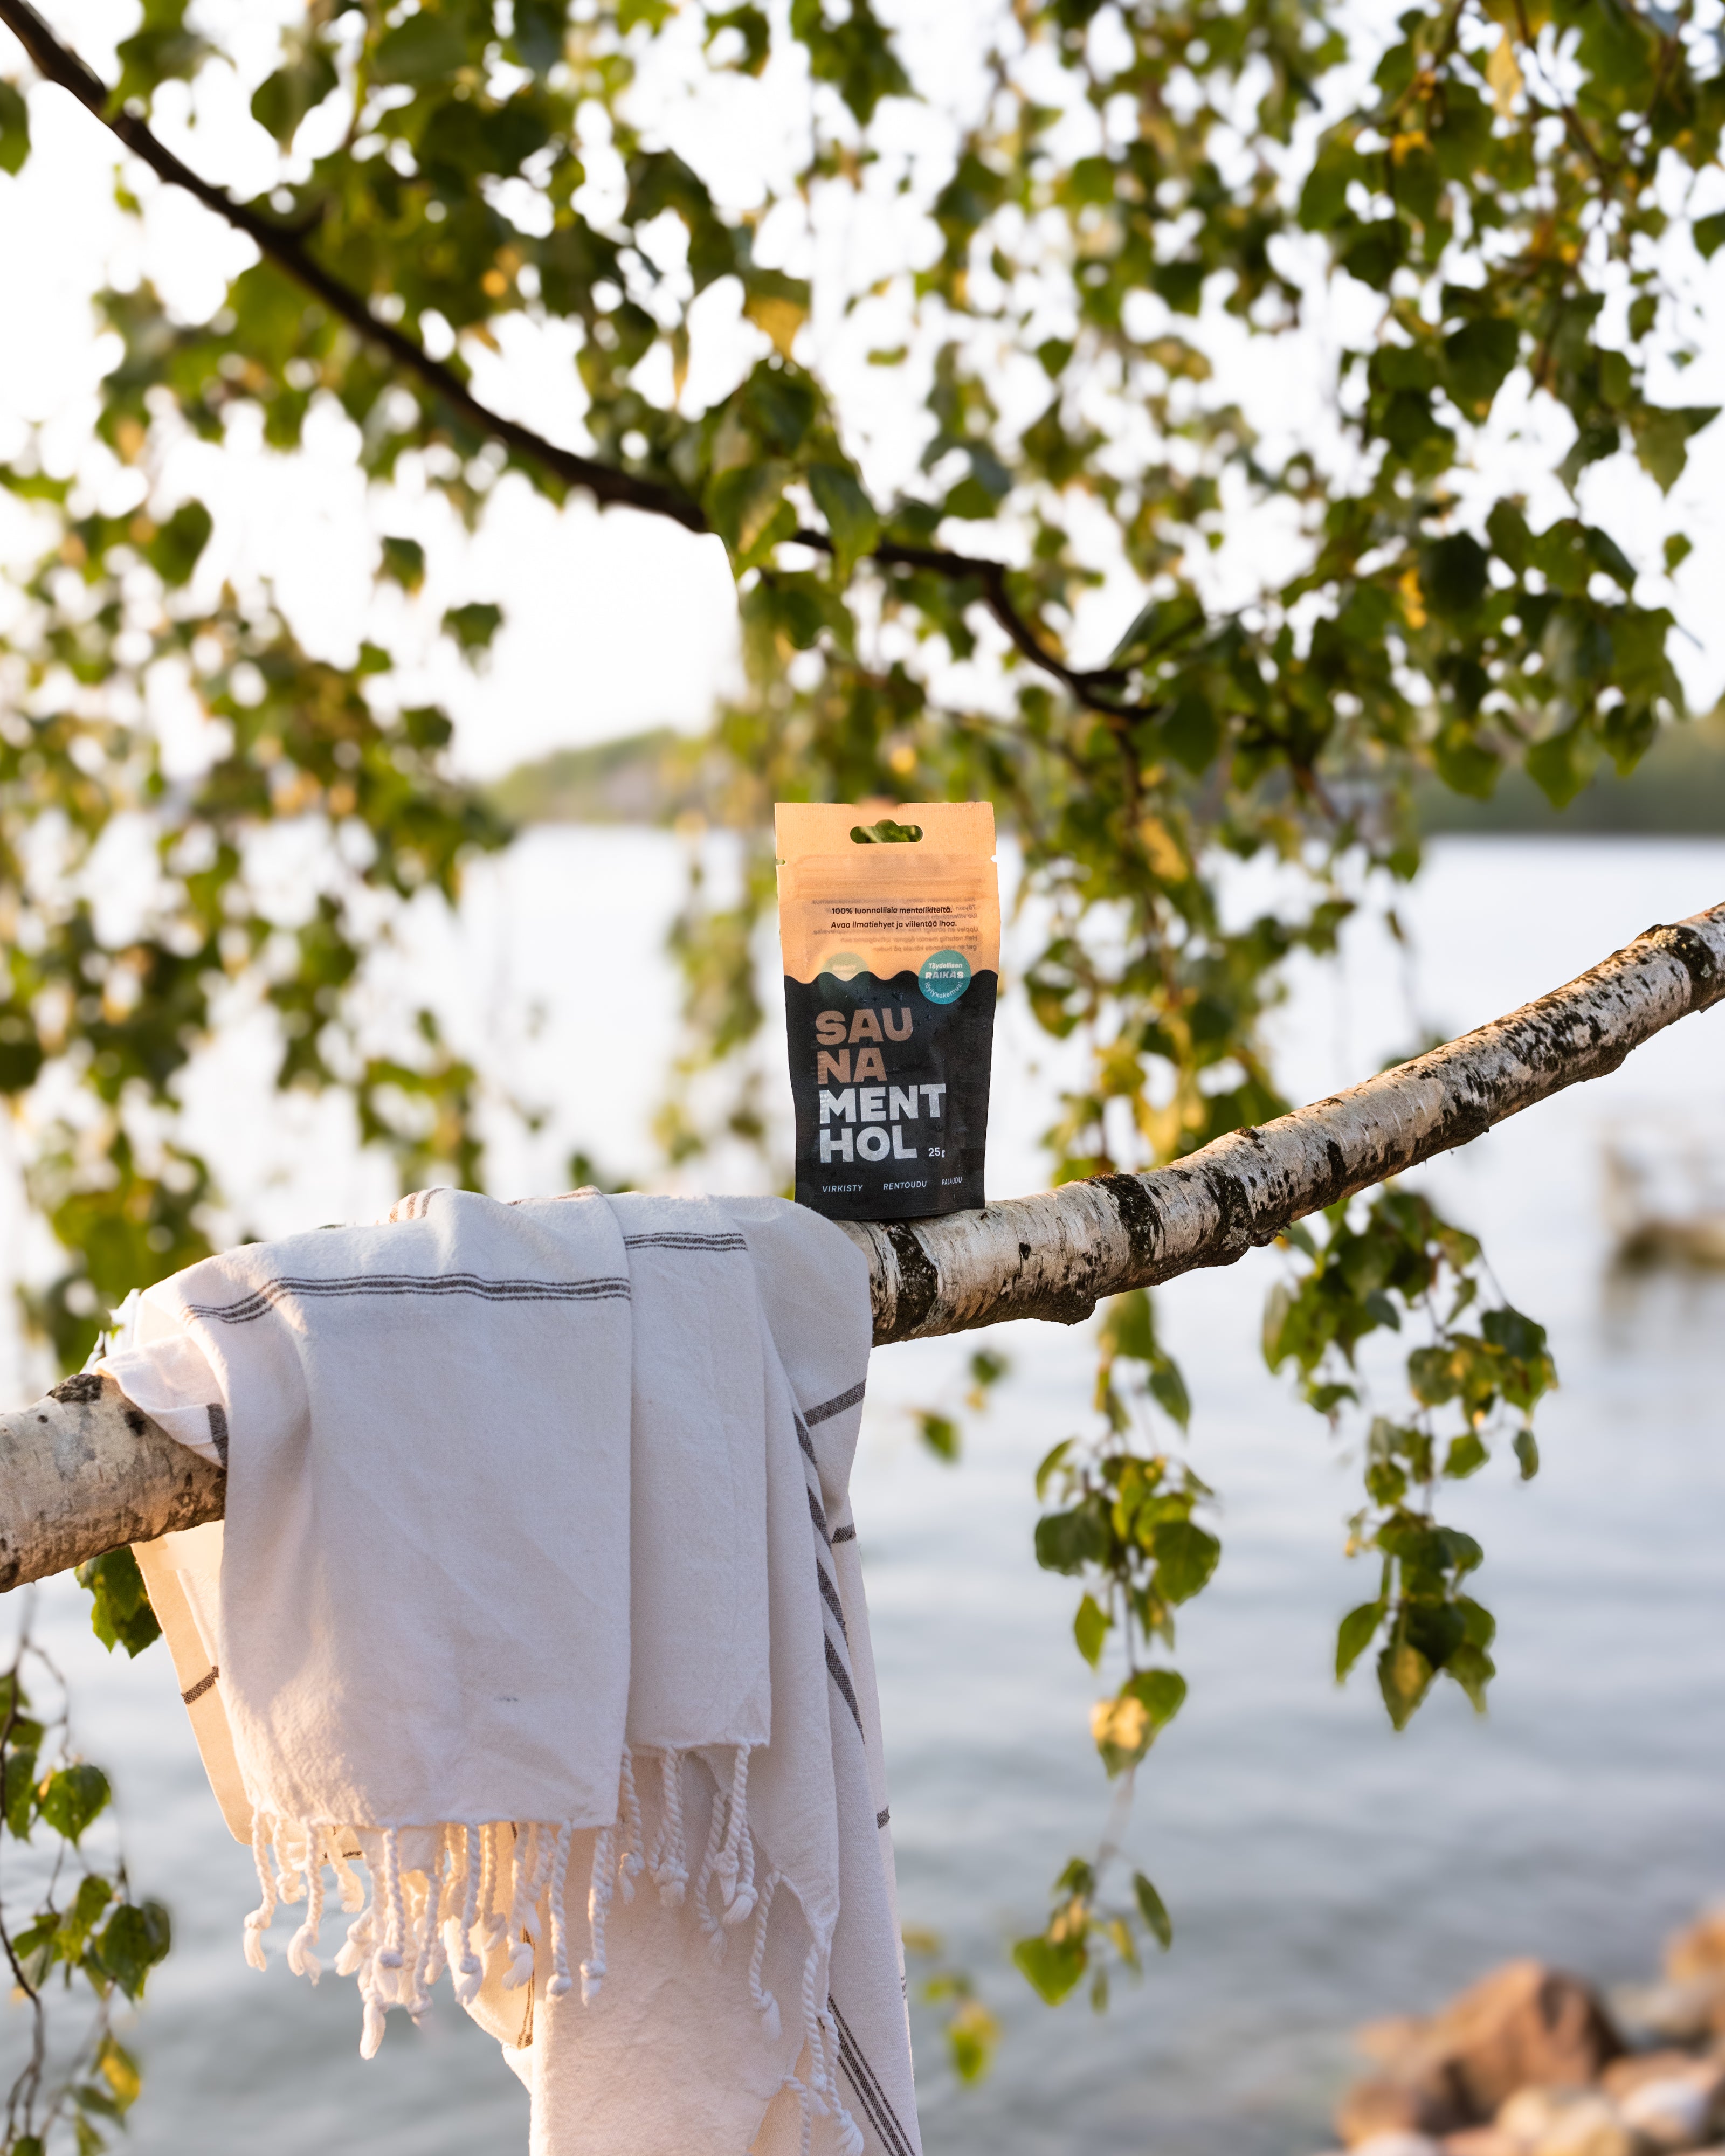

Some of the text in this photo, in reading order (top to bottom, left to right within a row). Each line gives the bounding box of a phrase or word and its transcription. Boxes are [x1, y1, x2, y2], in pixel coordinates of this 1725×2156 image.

[852, 921, 895, 929] ilmatiehyet
[896, 921, 903, 929] ja
[929, 962, 963, 970] Täydellisen
[924, 982, 963, 998] löylykokemus!
[816, 1007, 913, 1045] SAU
[817, 1048, 888, 1084] NA
[819, 1083, 946, 1124] MENT
[819, 1125, 917, 1163] HOL
[883, 1180, 927, 1190] RENTOUDU
[941, 1177, 962, 1185] PALAUDU
